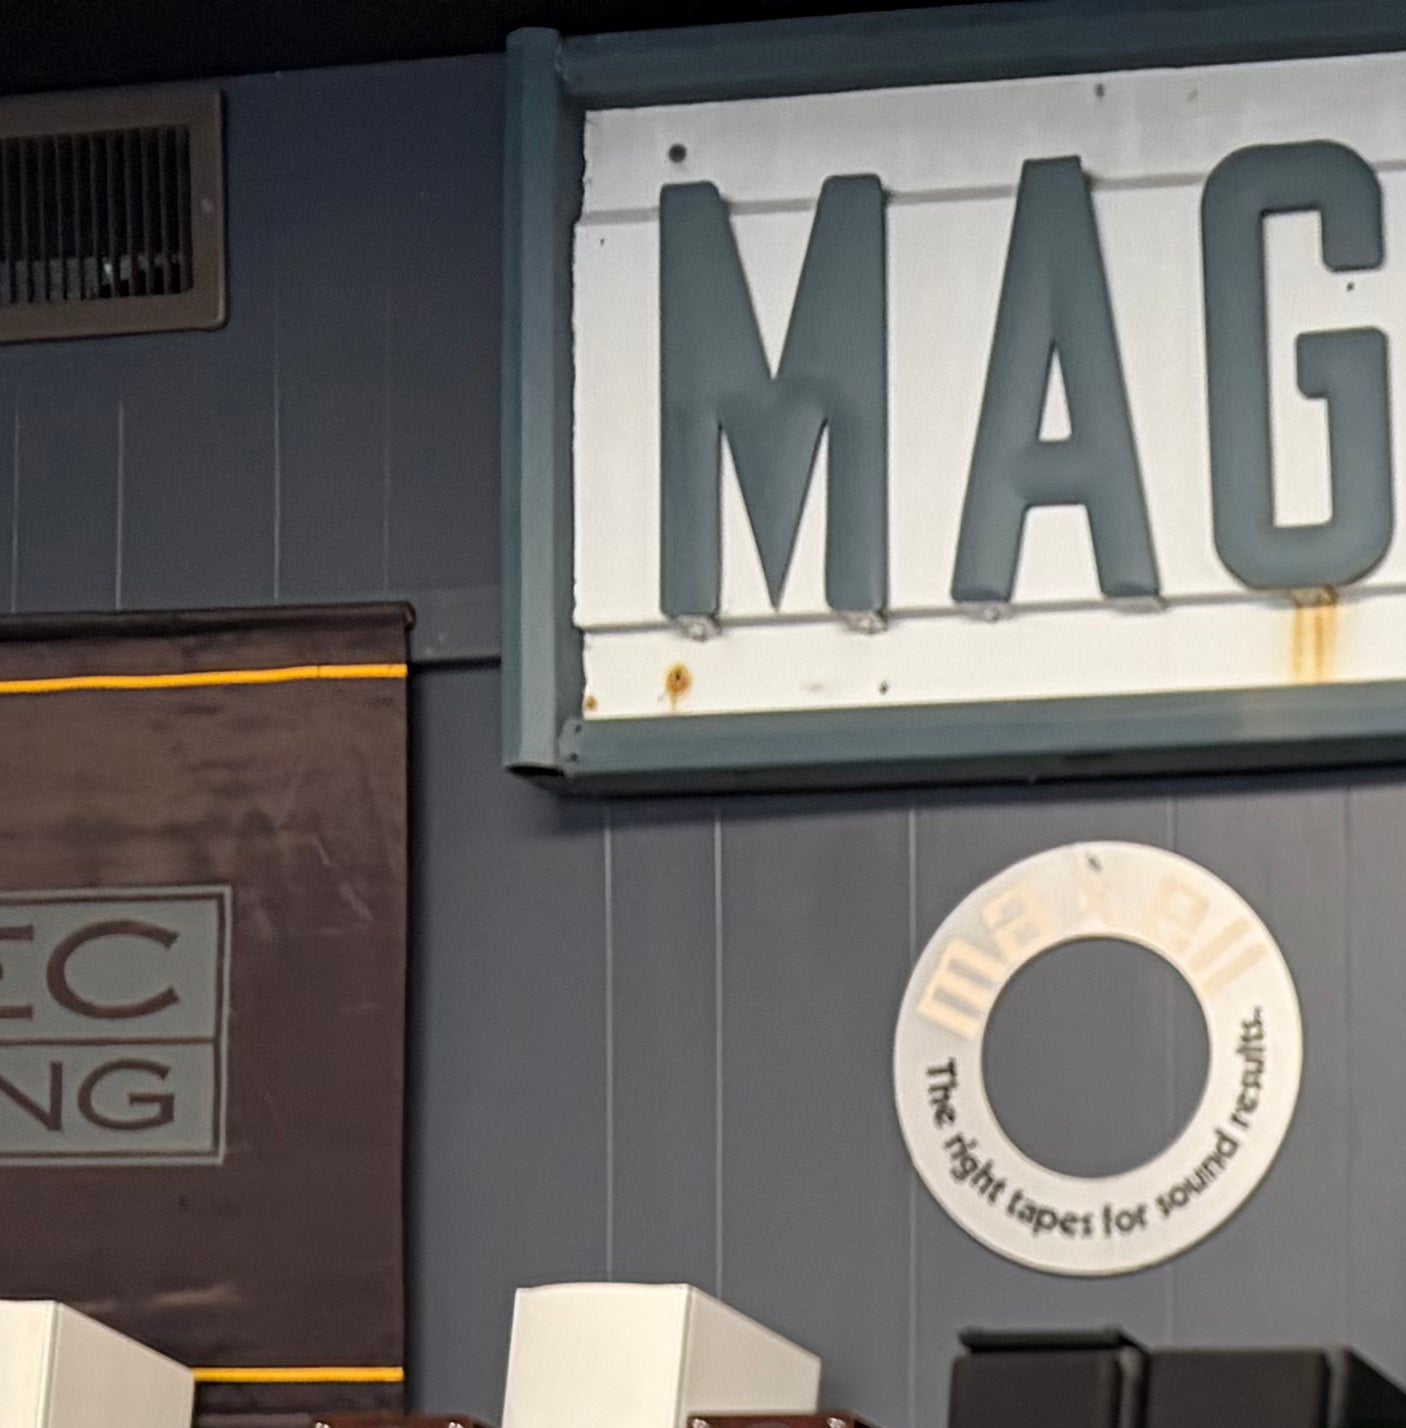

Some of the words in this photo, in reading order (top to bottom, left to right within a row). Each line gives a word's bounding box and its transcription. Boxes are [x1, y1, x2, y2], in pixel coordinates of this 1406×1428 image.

[926, 1057, 957, 1130] The
[945, 1132, 1007, 1206] right
[1006, 1187, 1094, 1238] tapes
[1102, 1205, 1149, 1237] for
[1158, 1130, 1239, 1218] sound
